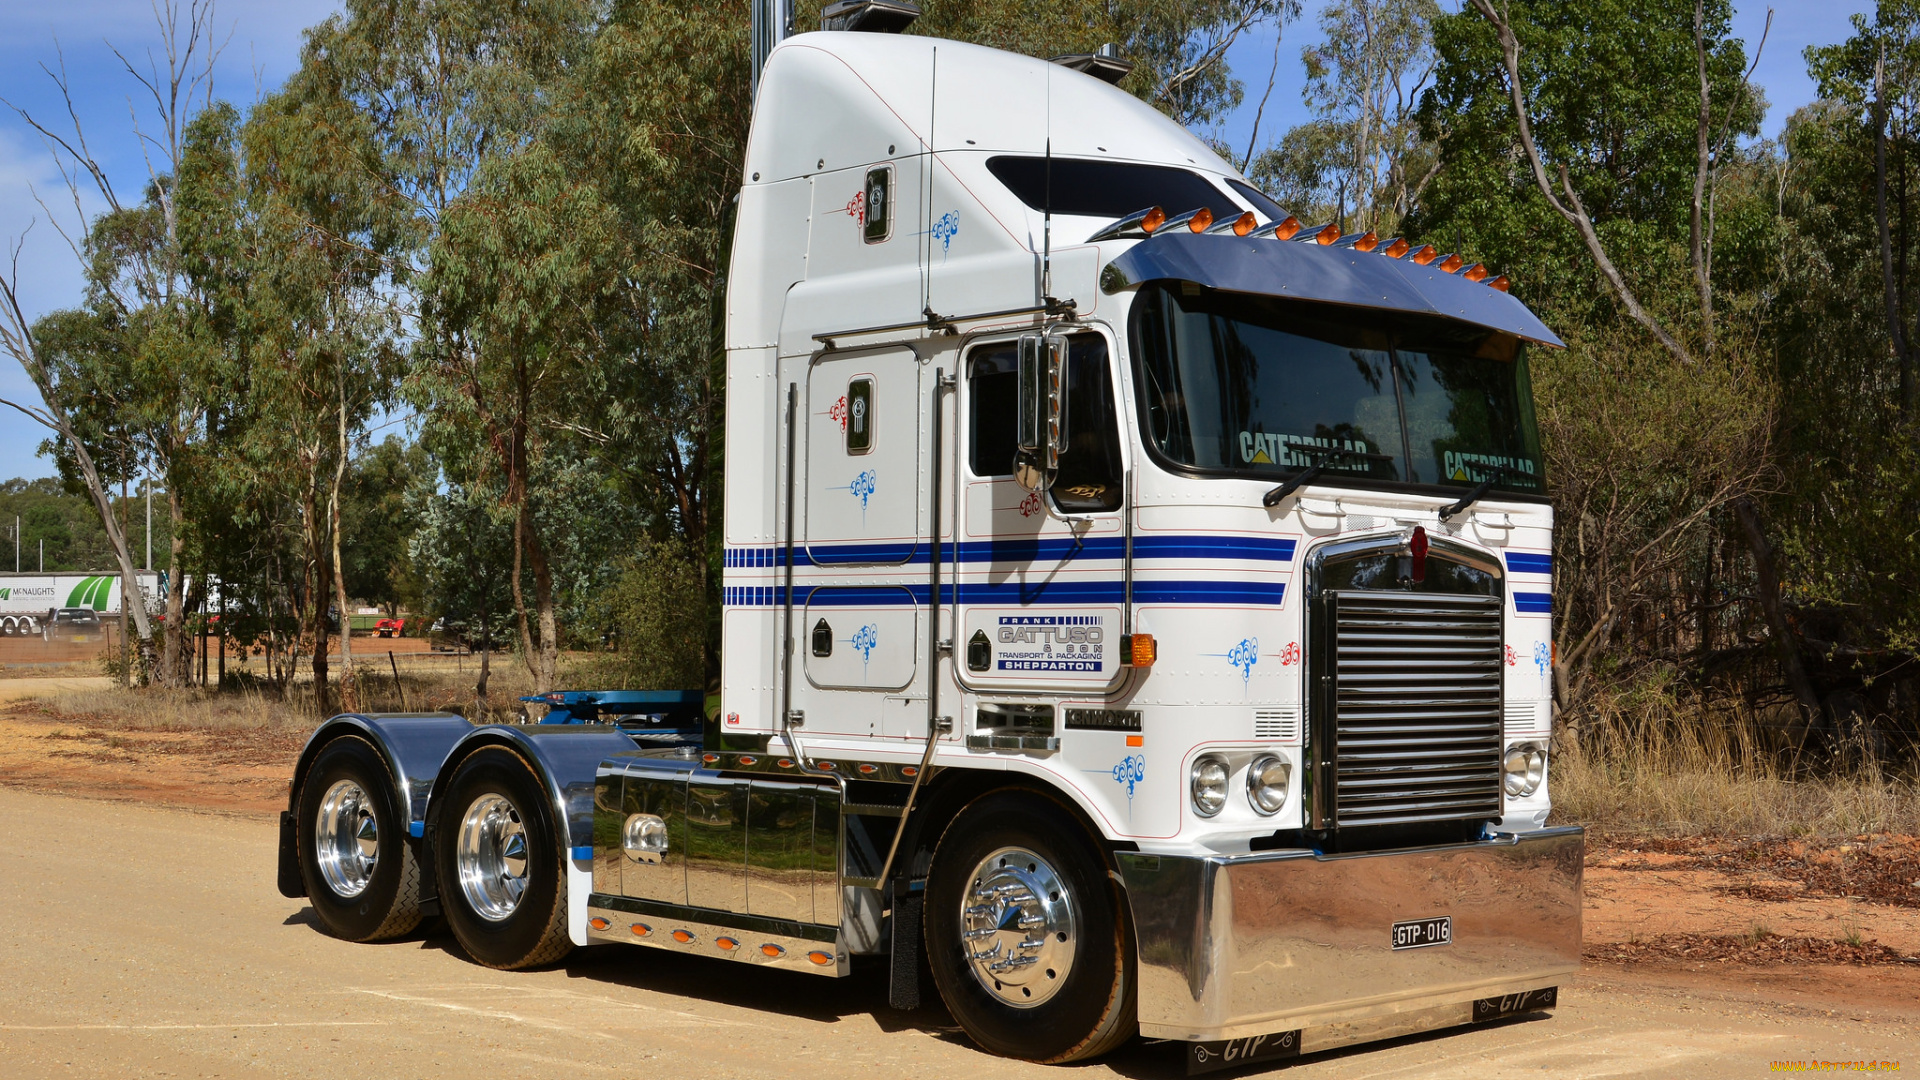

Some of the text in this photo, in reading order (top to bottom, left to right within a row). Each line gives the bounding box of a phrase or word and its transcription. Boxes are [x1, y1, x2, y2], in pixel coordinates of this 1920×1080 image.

[998, 627, 1104, 644] GATTUSO
[1043, 644, 1103, 653] & SON
[1005, 661, 1095, 671] SHEPPARTON
[1066, 709, 1140, 727] KENWORTH
